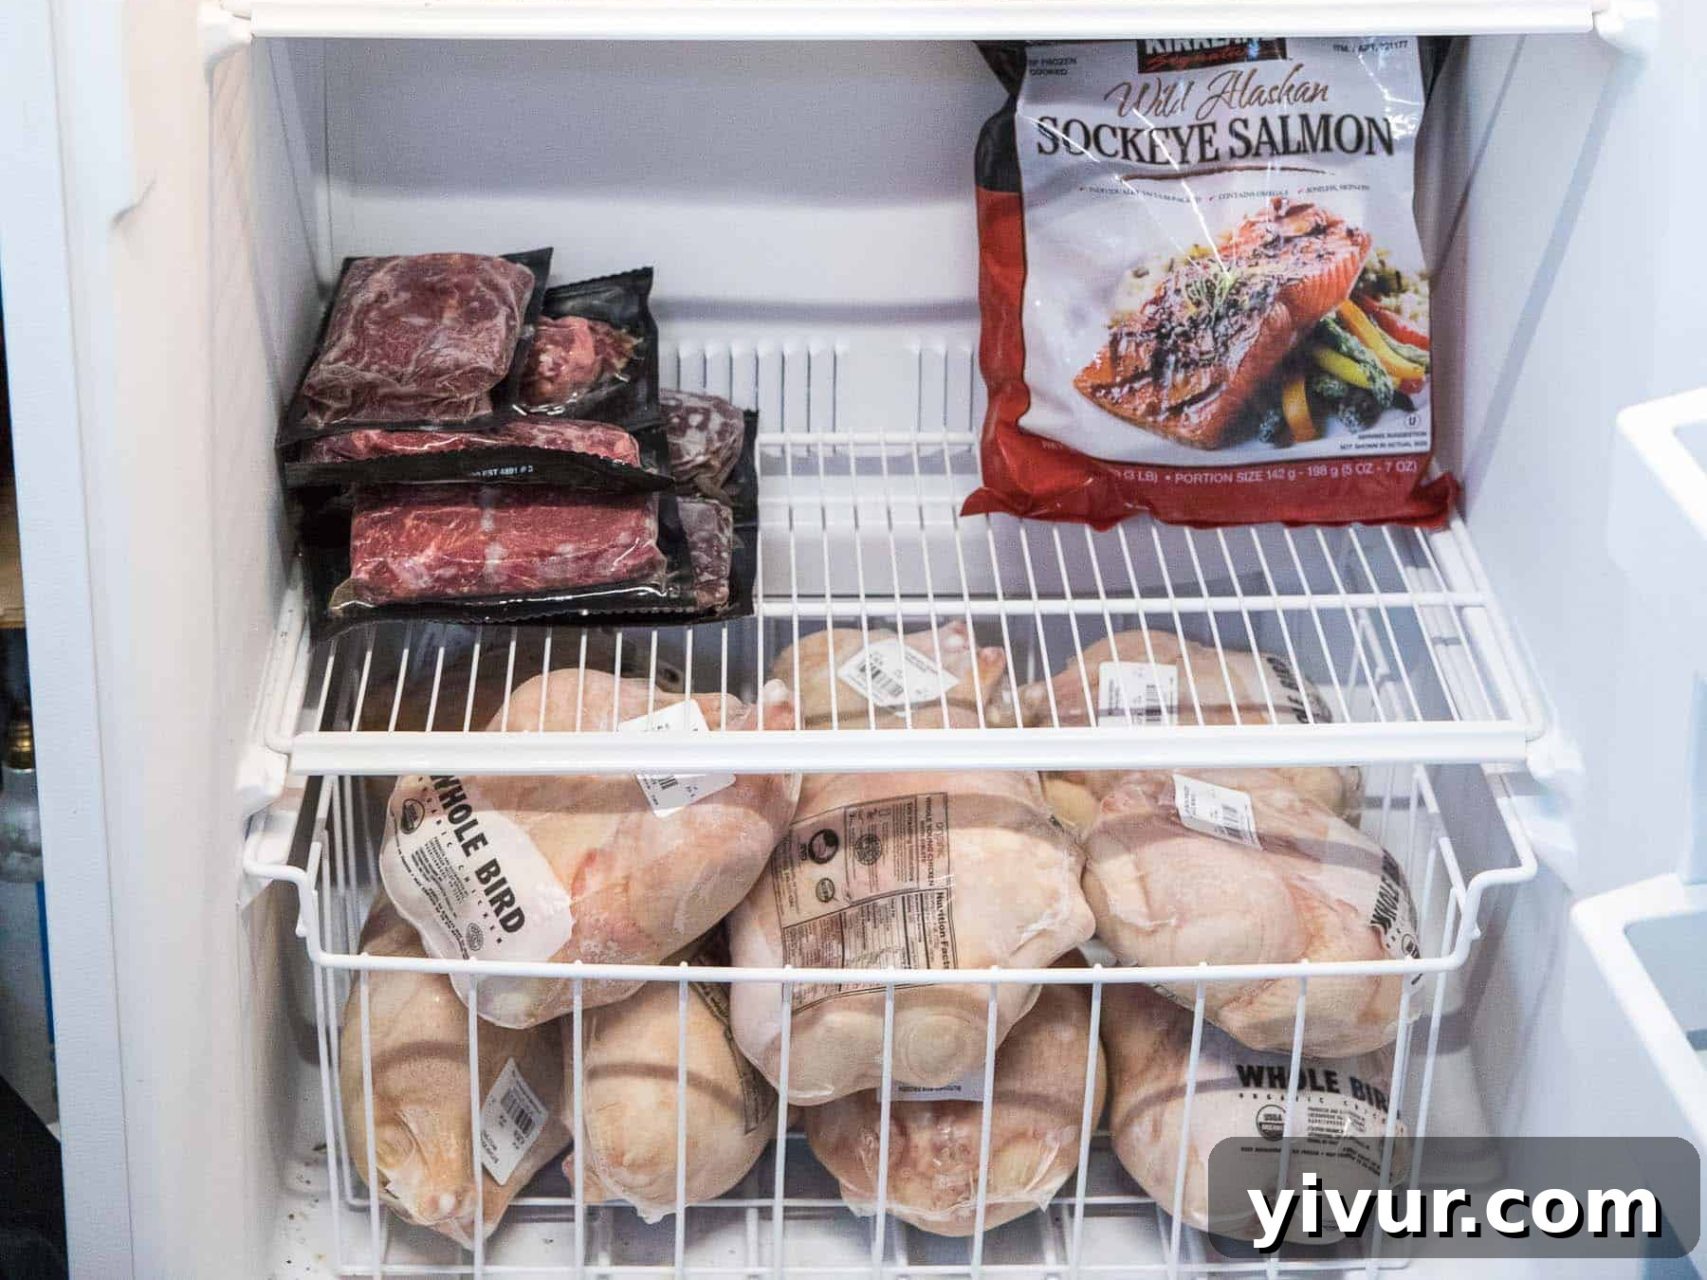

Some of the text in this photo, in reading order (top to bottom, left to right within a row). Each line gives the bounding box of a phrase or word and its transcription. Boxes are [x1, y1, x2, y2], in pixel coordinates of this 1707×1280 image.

[1103, 63, 1330, 121] Wild Alaskan
[1036, 112, 1395, 166] SOCKEYE SALMON
[1175, 472, 1234, 484] PORTION
[1237, 470, 1264, 483] SIZE
[1355, 463, 1375, 476] OZ
[1396, 459, 1417, 473] OZ)
[430, 775, 489, 858] WHOLE
[475, 857, 526, 934] BIRD
[927, 852, 935, 887] CHICKEN
[936, 892, 951, 969] Nutrition Facts
[1236, 1064, 1400, 1121] WHOLE BIR
